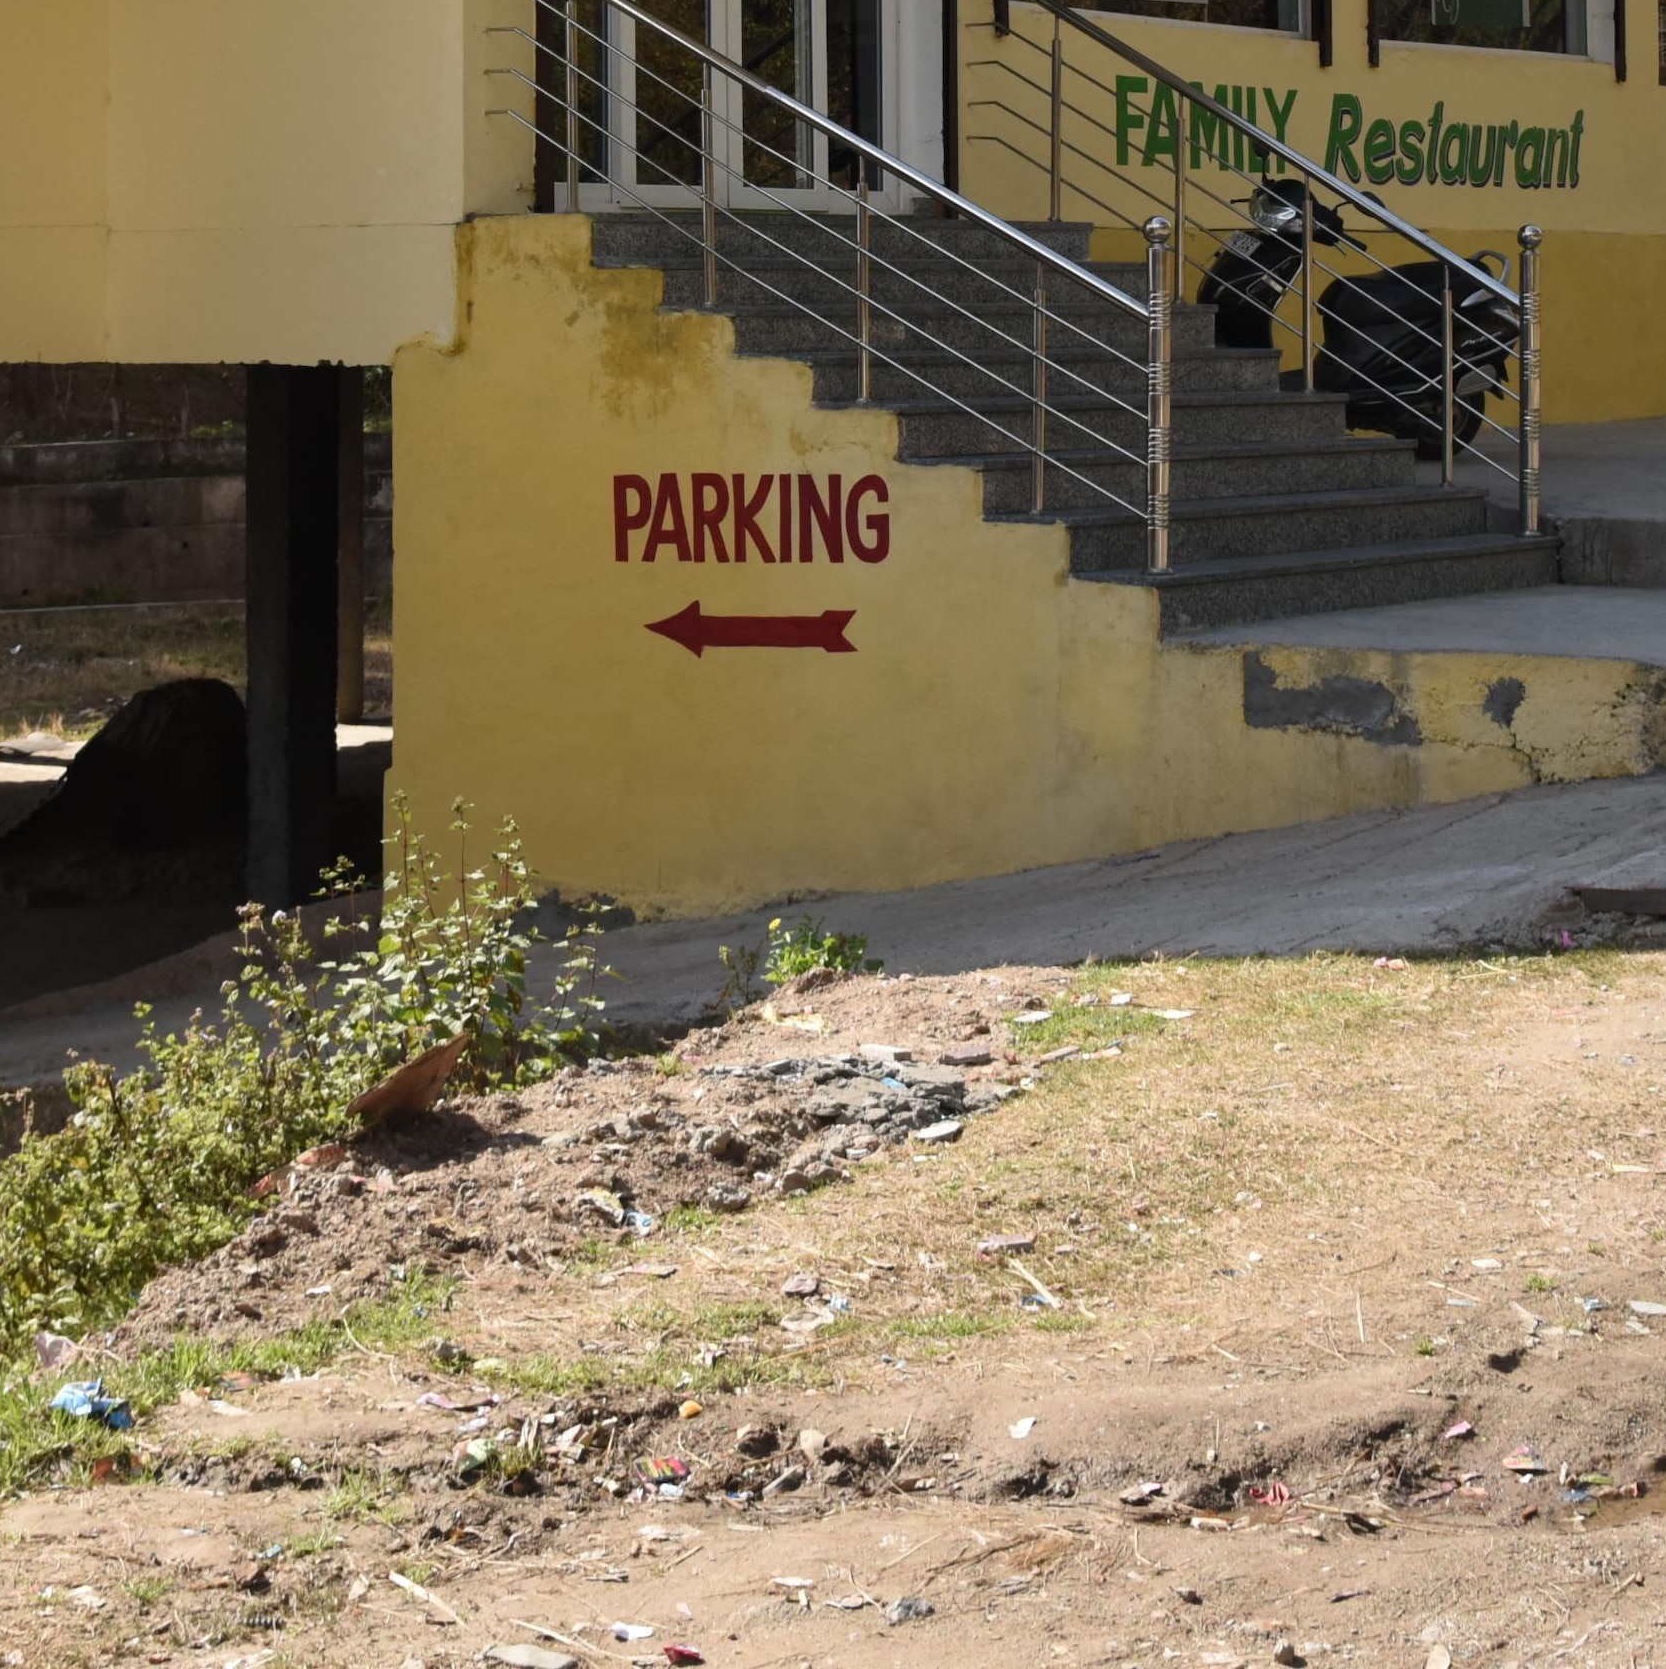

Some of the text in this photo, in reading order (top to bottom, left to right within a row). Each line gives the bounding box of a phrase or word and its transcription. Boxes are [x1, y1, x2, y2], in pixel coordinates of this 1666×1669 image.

[1115, 75, 1584, 188] FAMILY Restaurant
[613, 473, 890, 563] PARKING
